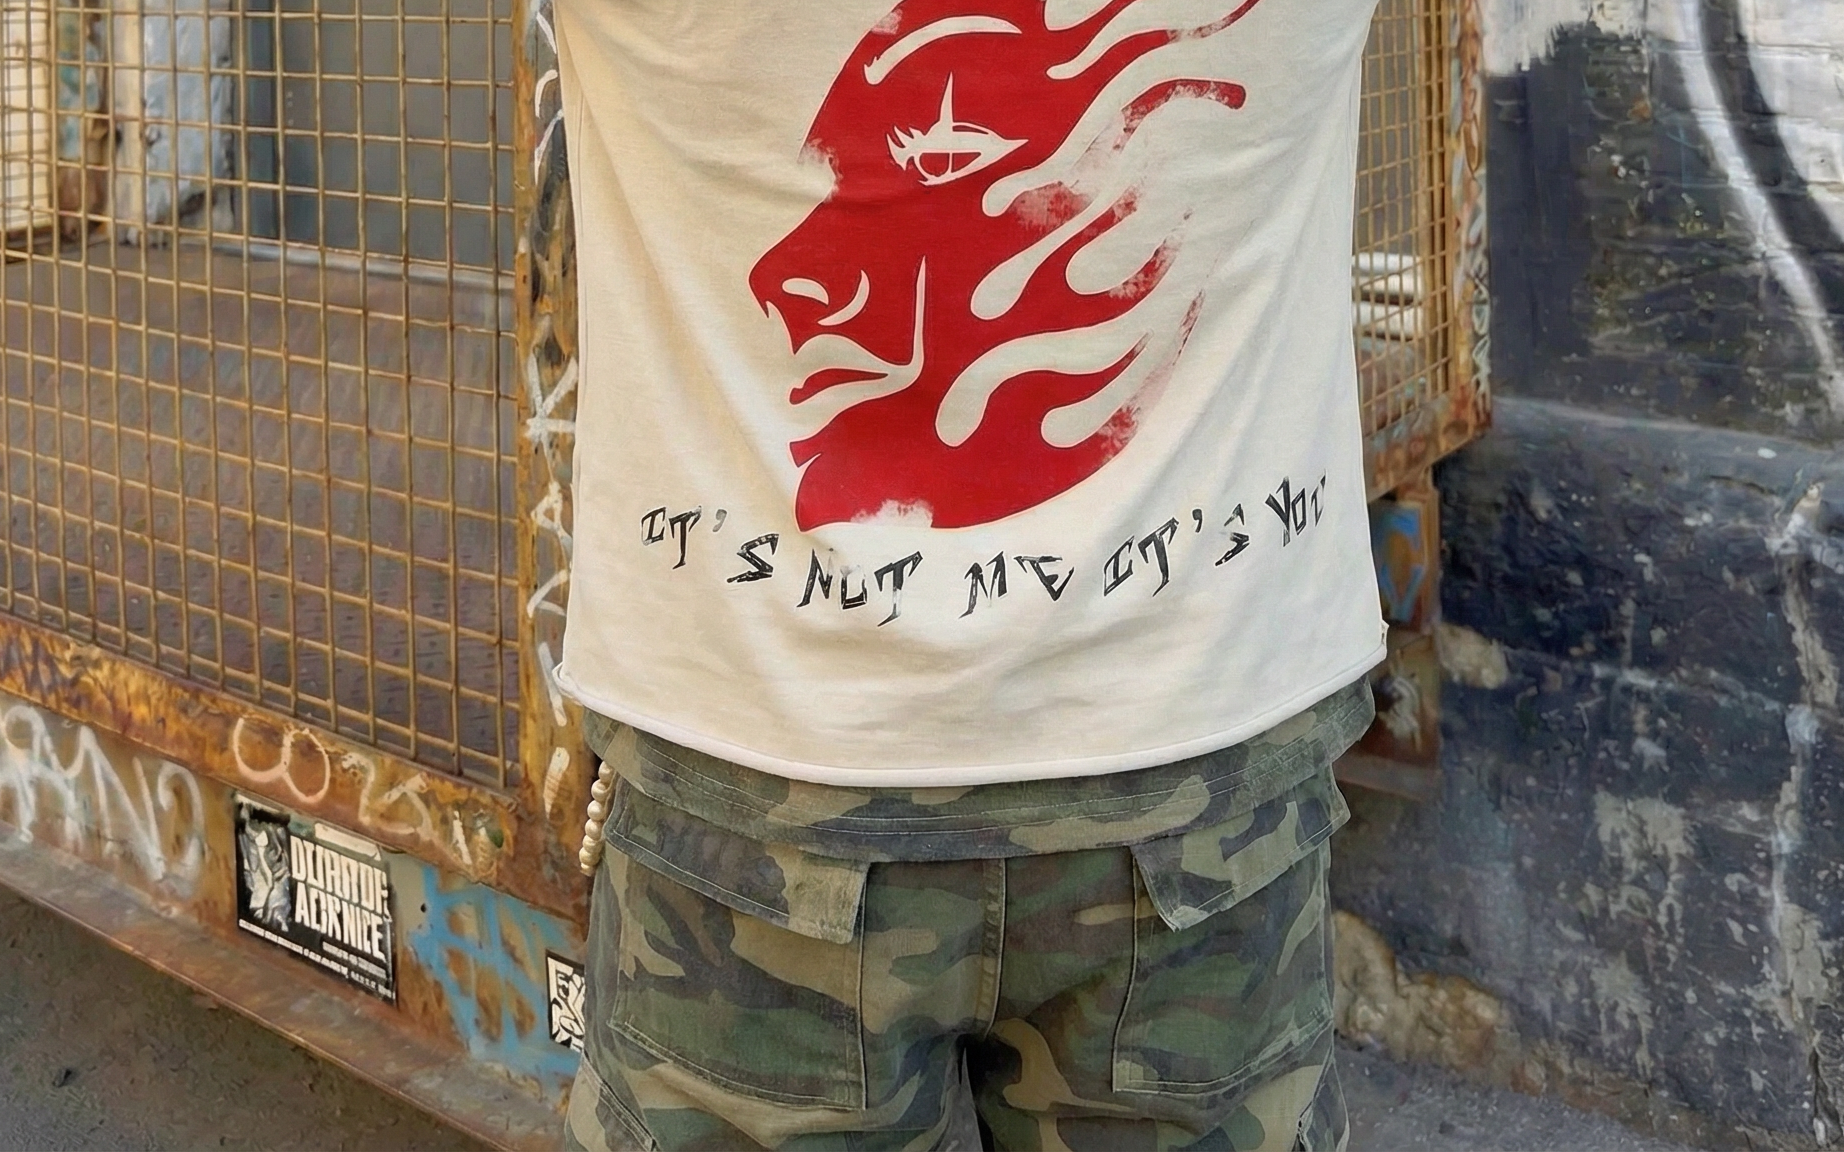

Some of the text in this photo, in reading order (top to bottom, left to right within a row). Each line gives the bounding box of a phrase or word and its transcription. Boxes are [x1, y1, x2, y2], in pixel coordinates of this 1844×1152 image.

[640, 504, 780, 584] IT'S
[796, 546, 924, 628] NOT
[957, 550, 1075, 620] ME
[1102, 502, 1251, 598] IT'S
